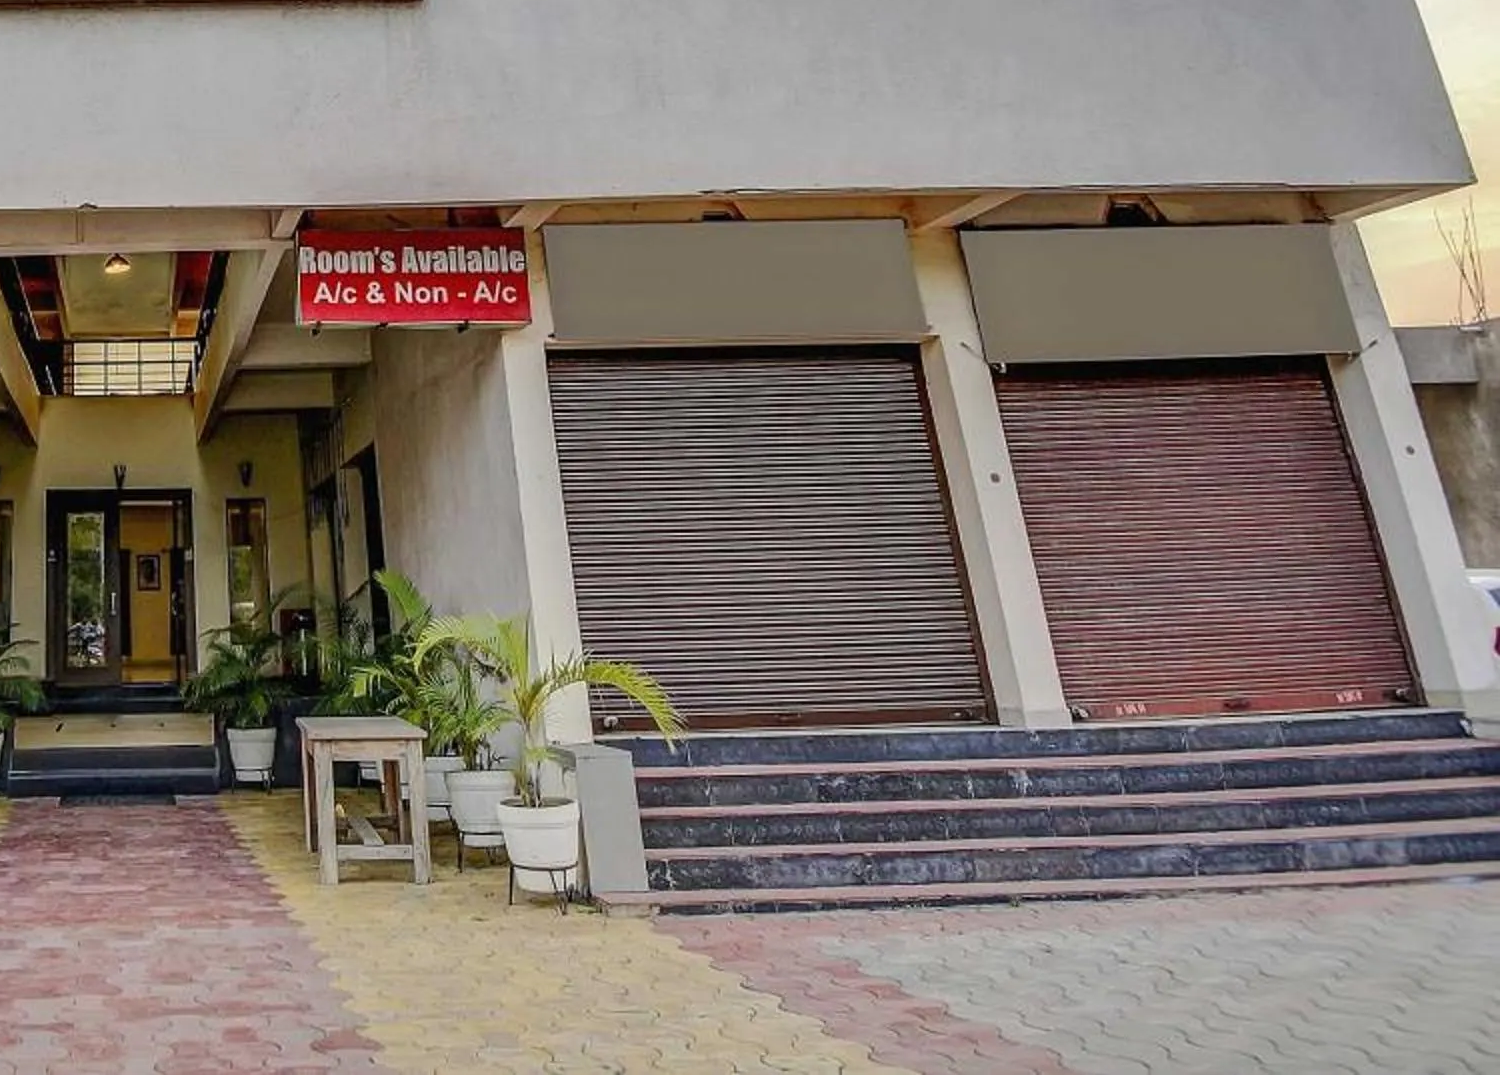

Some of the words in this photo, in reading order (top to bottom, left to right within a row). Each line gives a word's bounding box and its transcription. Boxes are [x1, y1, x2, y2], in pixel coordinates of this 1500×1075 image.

[300, 246, 396, 274] Room's
[401, 245, 525, 274] Available
[313, 281, 357, 304] A/c
[366, 281, 386, 304] &
[395, 282, 448, 304] Non
[473, 280, 517, 304] A/c
